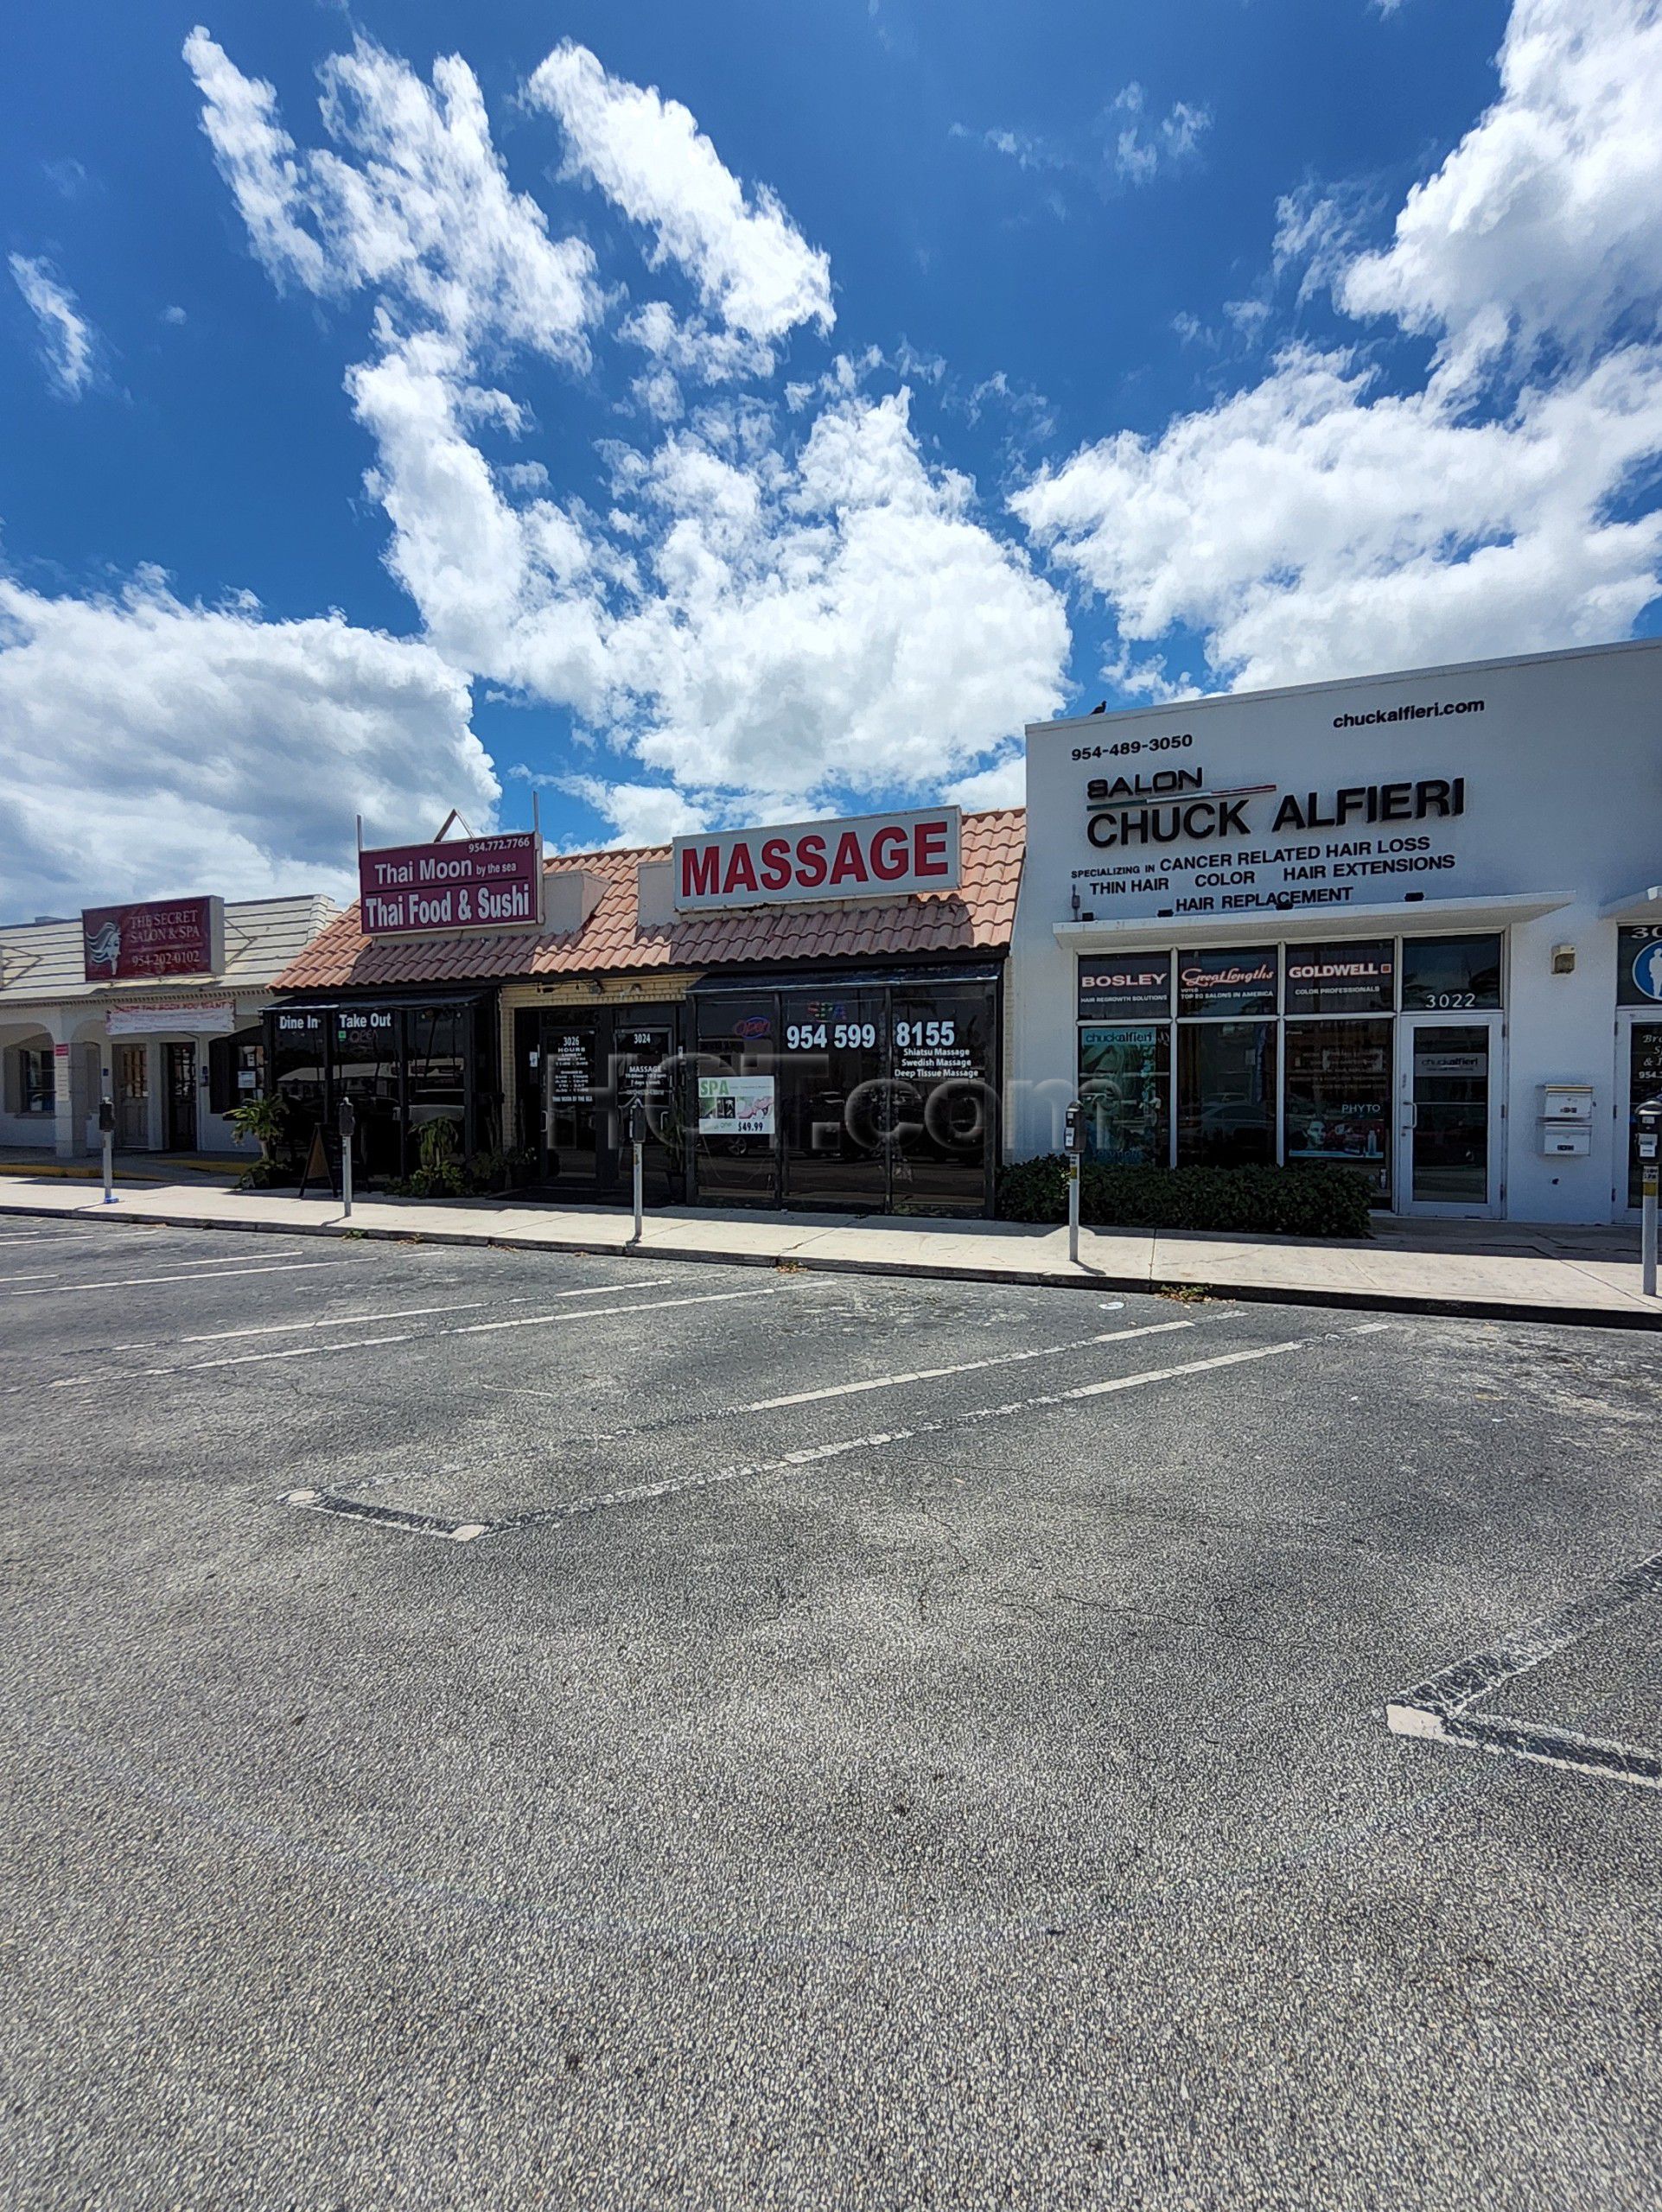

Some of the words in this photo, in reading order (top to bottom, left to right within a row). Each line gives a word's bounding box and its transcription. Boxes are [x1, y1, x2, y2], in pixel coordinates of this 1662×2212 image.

[1333, 700, 1485, 728] chuckalfieri.com
[1072, 734, 1193, 760] 954-489-3050
[1087, 767, 1202, 799] SALON
[1087, 799, 1251, 849] CHUCK
[1271, 777, 1465, 833] ALFIERI
[468, 836, 530, 854] 954.772.7766
[682, 821, 949, 897] MASSAGE
[1071, 866, 1140, 879] SPECIALIZING
[1160, 853, 1232, 872] CANCER
[1238, 846, 1321, 865] RELATED
[1326, 842, 1372, 858] HAIR
[1378, 836, 1430, 854] LOSS
[374, 861, 413, 885] Thai
[419, 858, 473, 880] Moon
[476, 865, 487, 877] by
[487, 864, 500, 874] the
[502, 862, 517, 872] sea
[1090, 880, 1126, 895] THIN
[1130, 877, 1169, 893] HAIR
[1194, 870, 1256, 887] COLOR
[1283, 865, 1326, 881] HAIR
[1334, 855, 1455, 878] EXTENSIONS
[366, 895, 404, 928] Thai
[408, 891, 452, 925] Food
[458, 889, 472, 920] &
[477, 884, 529, 919] Sushi
[1175, 897, 1214, 912] HAIR
[1221, 887, 1353, 909] REPLACEMENT
[131, 915, 151, 929] THE
[155, 910, 198, 925] SECRET
[131, 927, 167, 944] SALON
[169, 928, 177, 939] &
[180, 925, 200, 939] SPA
[132, 950, 201, 967] 954-202-0102
[1289, 963, 1379, 978] GOLDWELL
[1081, 973, 1167, 988] BOSLEY
[1425, 993, 1476, 1008] 3022
[279, 1015, 303, 1030] Dine
[307, 1014, 318, 1028] In
[339, 1014, 367, 1028] Take
[370, 1013, 392, 1027] Out
[564, 1036, 580, 1046] 3026
[634, 1033, 651, 1044] 3024
[786, 1024, 827, 1049] 954
[834, 1024, 876, 1049] 599
[896, 1021, 955, 1046] 8155
[934, 1048, 970, 1057] Massage
[936, 1058, 971, 1068] Massage
[895, 1069, 915, 1078] Deep
[917, 1068, 941, 1077] Tissue
[943, 1069, 978, 1078] Massage
[701, 1080, 730, 1096] SPA
[1341, 1103, 1381, 1114] PHYTO
[738, 1122, 764, 1133] $49.99
